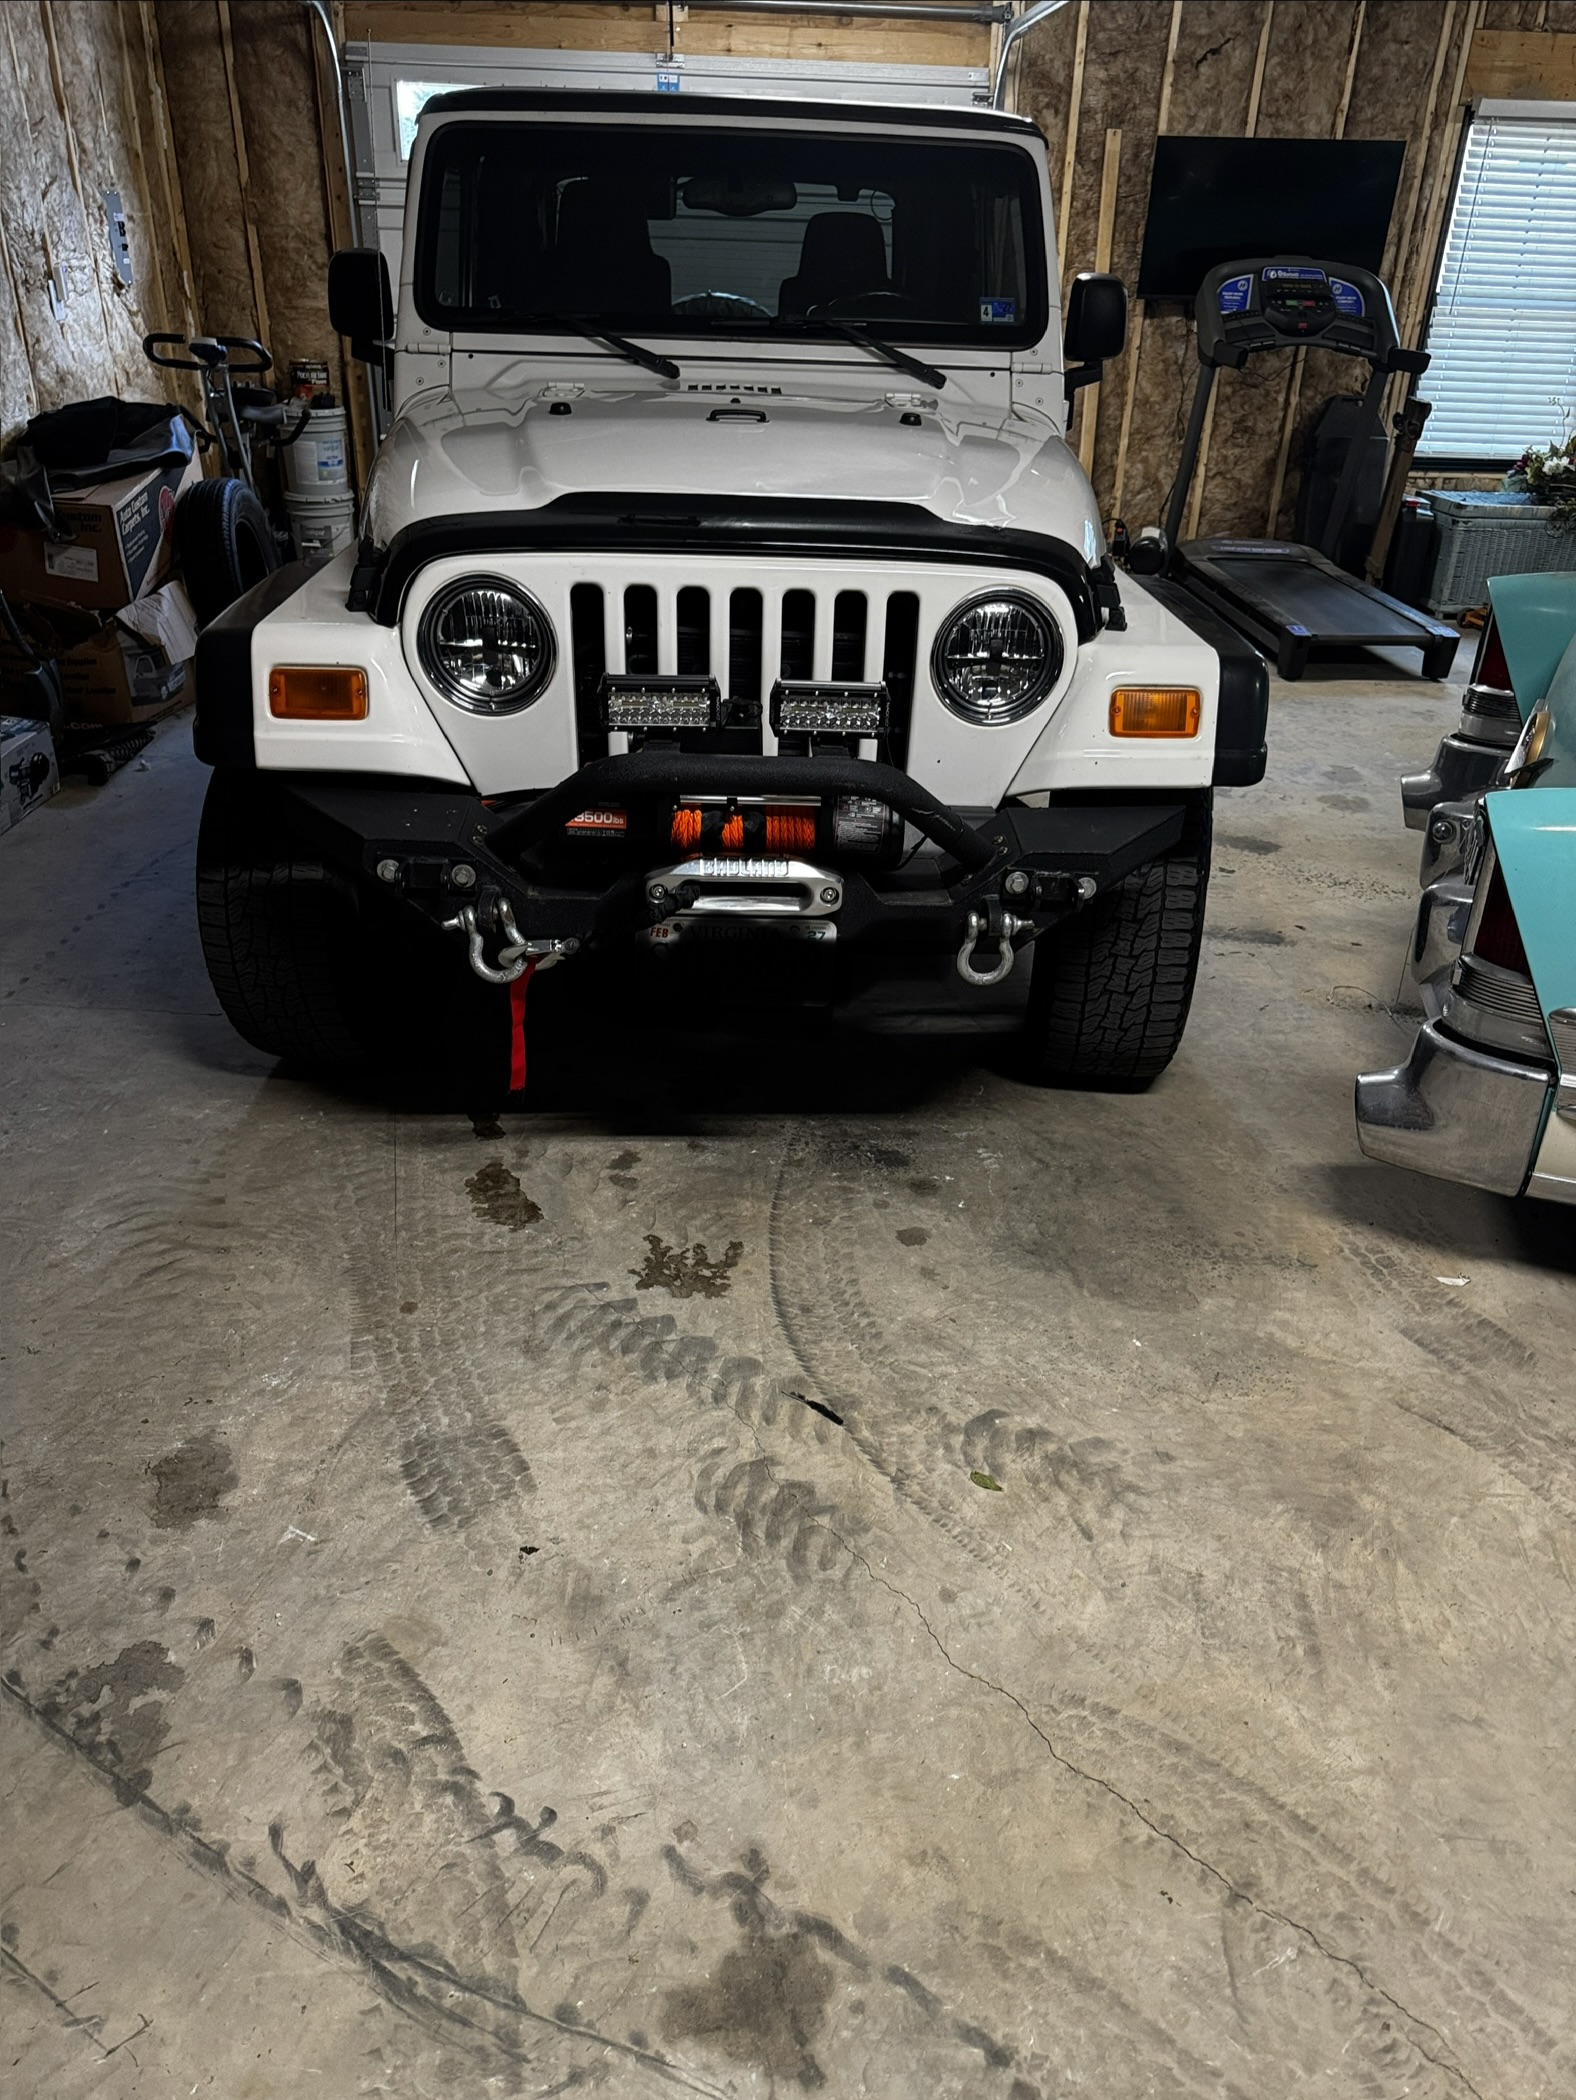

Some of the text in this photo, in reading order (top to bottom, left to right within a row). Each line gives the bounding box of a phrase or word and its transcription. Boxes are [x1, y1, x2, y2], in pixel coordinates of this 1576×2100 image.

[983, 306, 990, 317] 4
[120, 491, 149, 524] Auto Custom
[702, 859, 789, 877] BADLAND
[650, 927, 669, 938] FEB
[807, 931, 826, 942] 27
